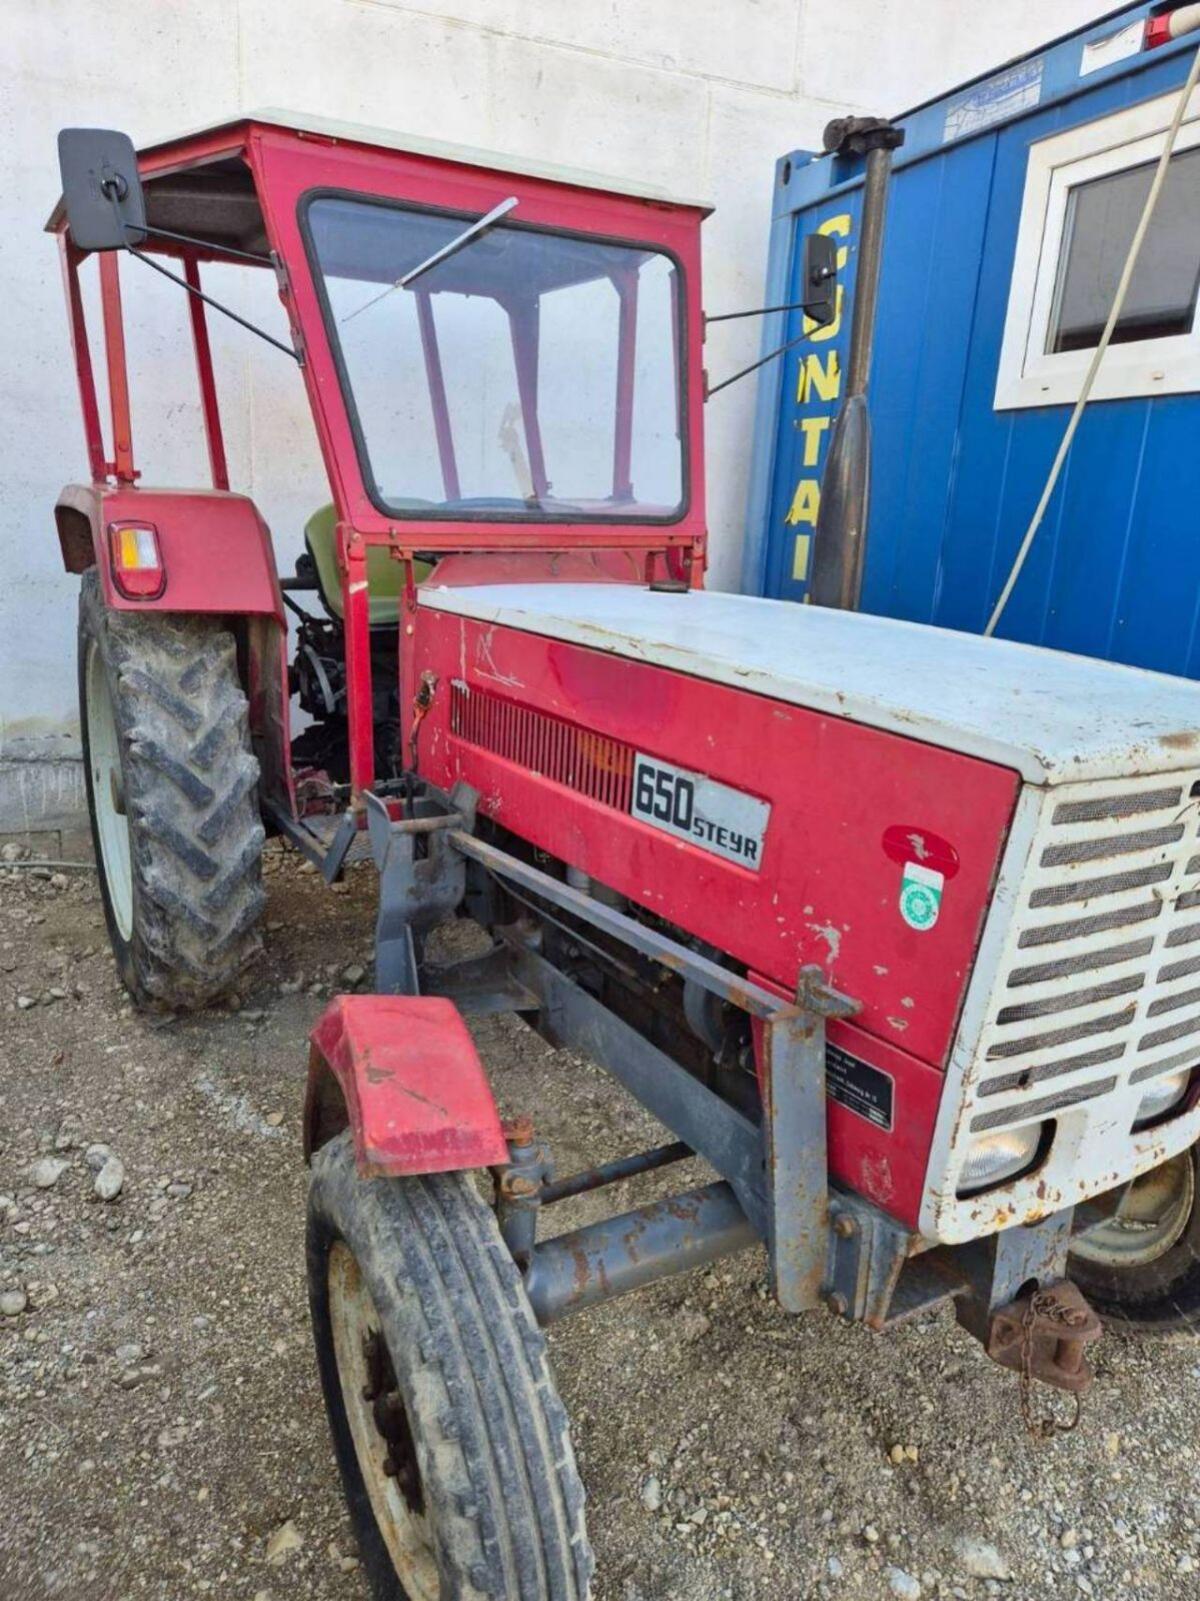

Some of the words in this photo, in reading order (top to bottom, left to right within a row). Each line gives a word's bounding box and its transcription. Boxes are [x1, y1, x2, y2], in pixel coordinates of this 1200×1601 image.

[785, 214, 851, 606] CONTAI
[635, 763, 695, 832] 650
[692, 816, 758, 861] STEYR
